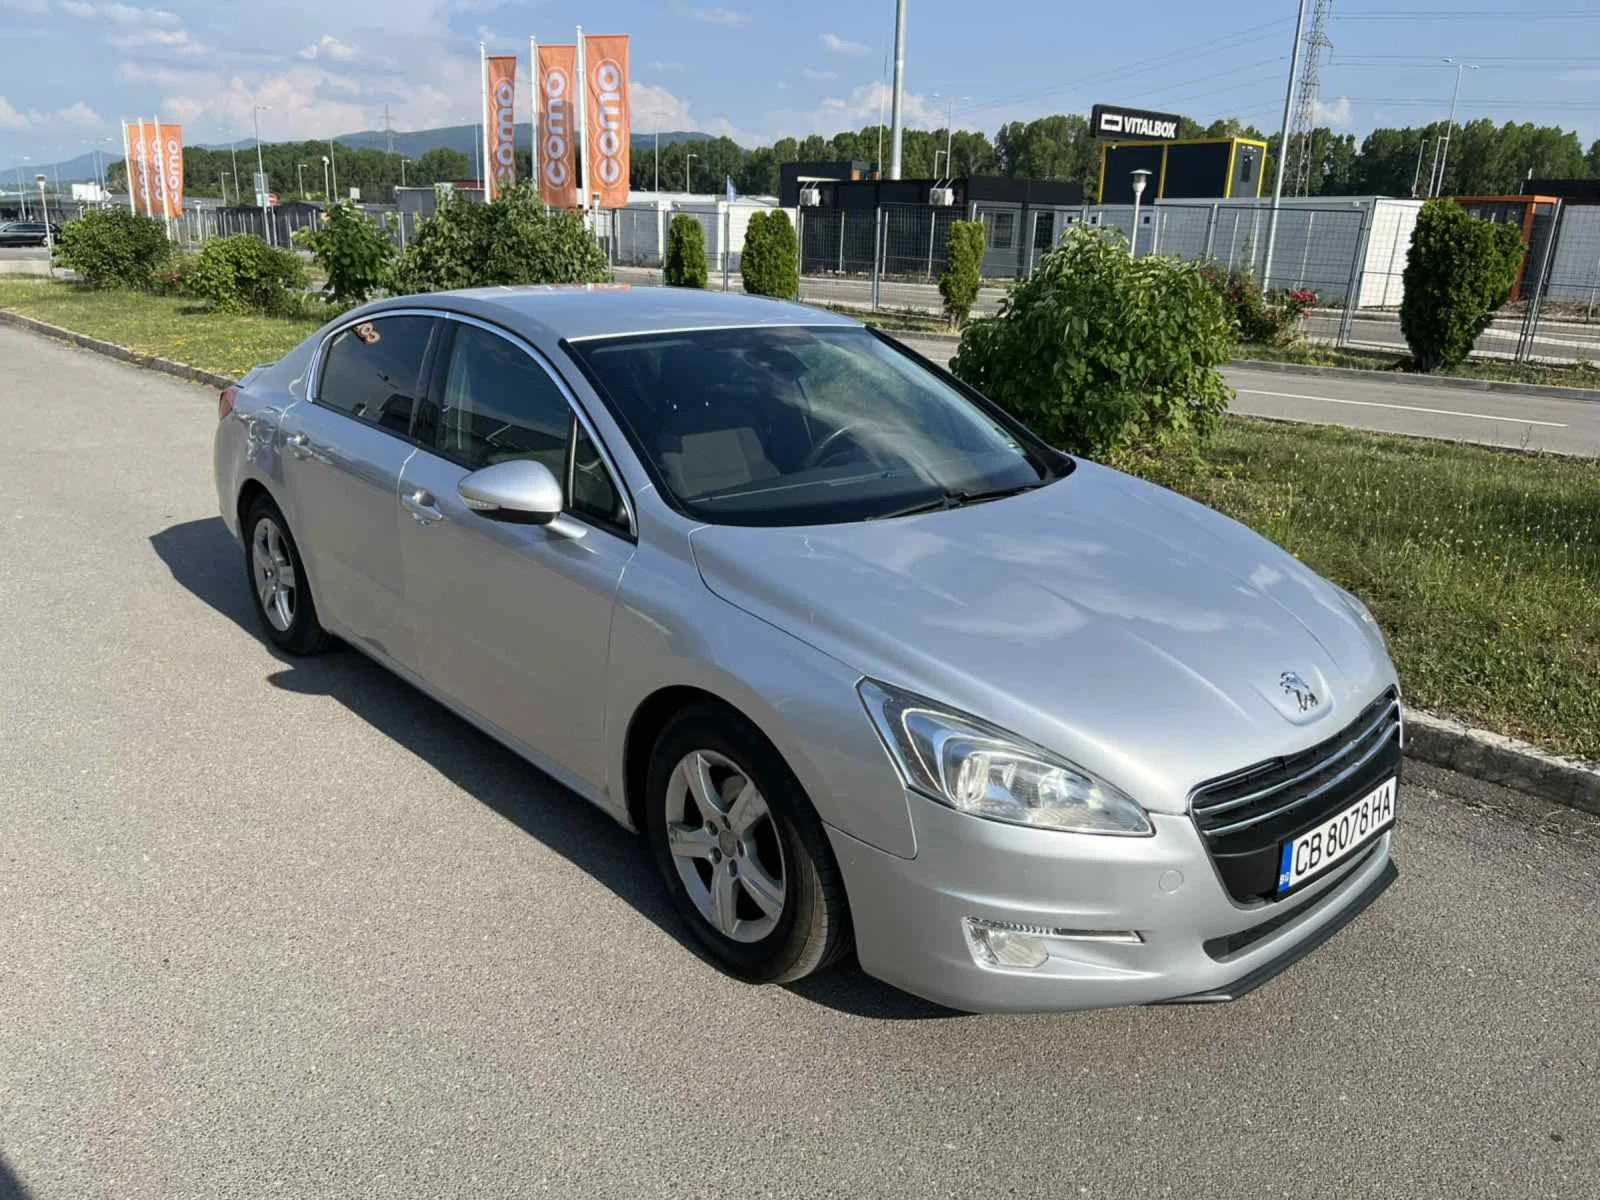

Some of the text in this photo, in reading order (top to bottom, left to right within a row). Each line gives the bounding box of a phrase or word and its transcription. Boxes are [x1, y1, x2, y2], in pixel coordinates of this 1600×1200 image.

[546, 71, 566, 185] como
[598, 63, 621, 183] como
[1124, 116, 1177, 138] VITALBOX
[1295, 786, 1391, 876] CB 8078 HA
